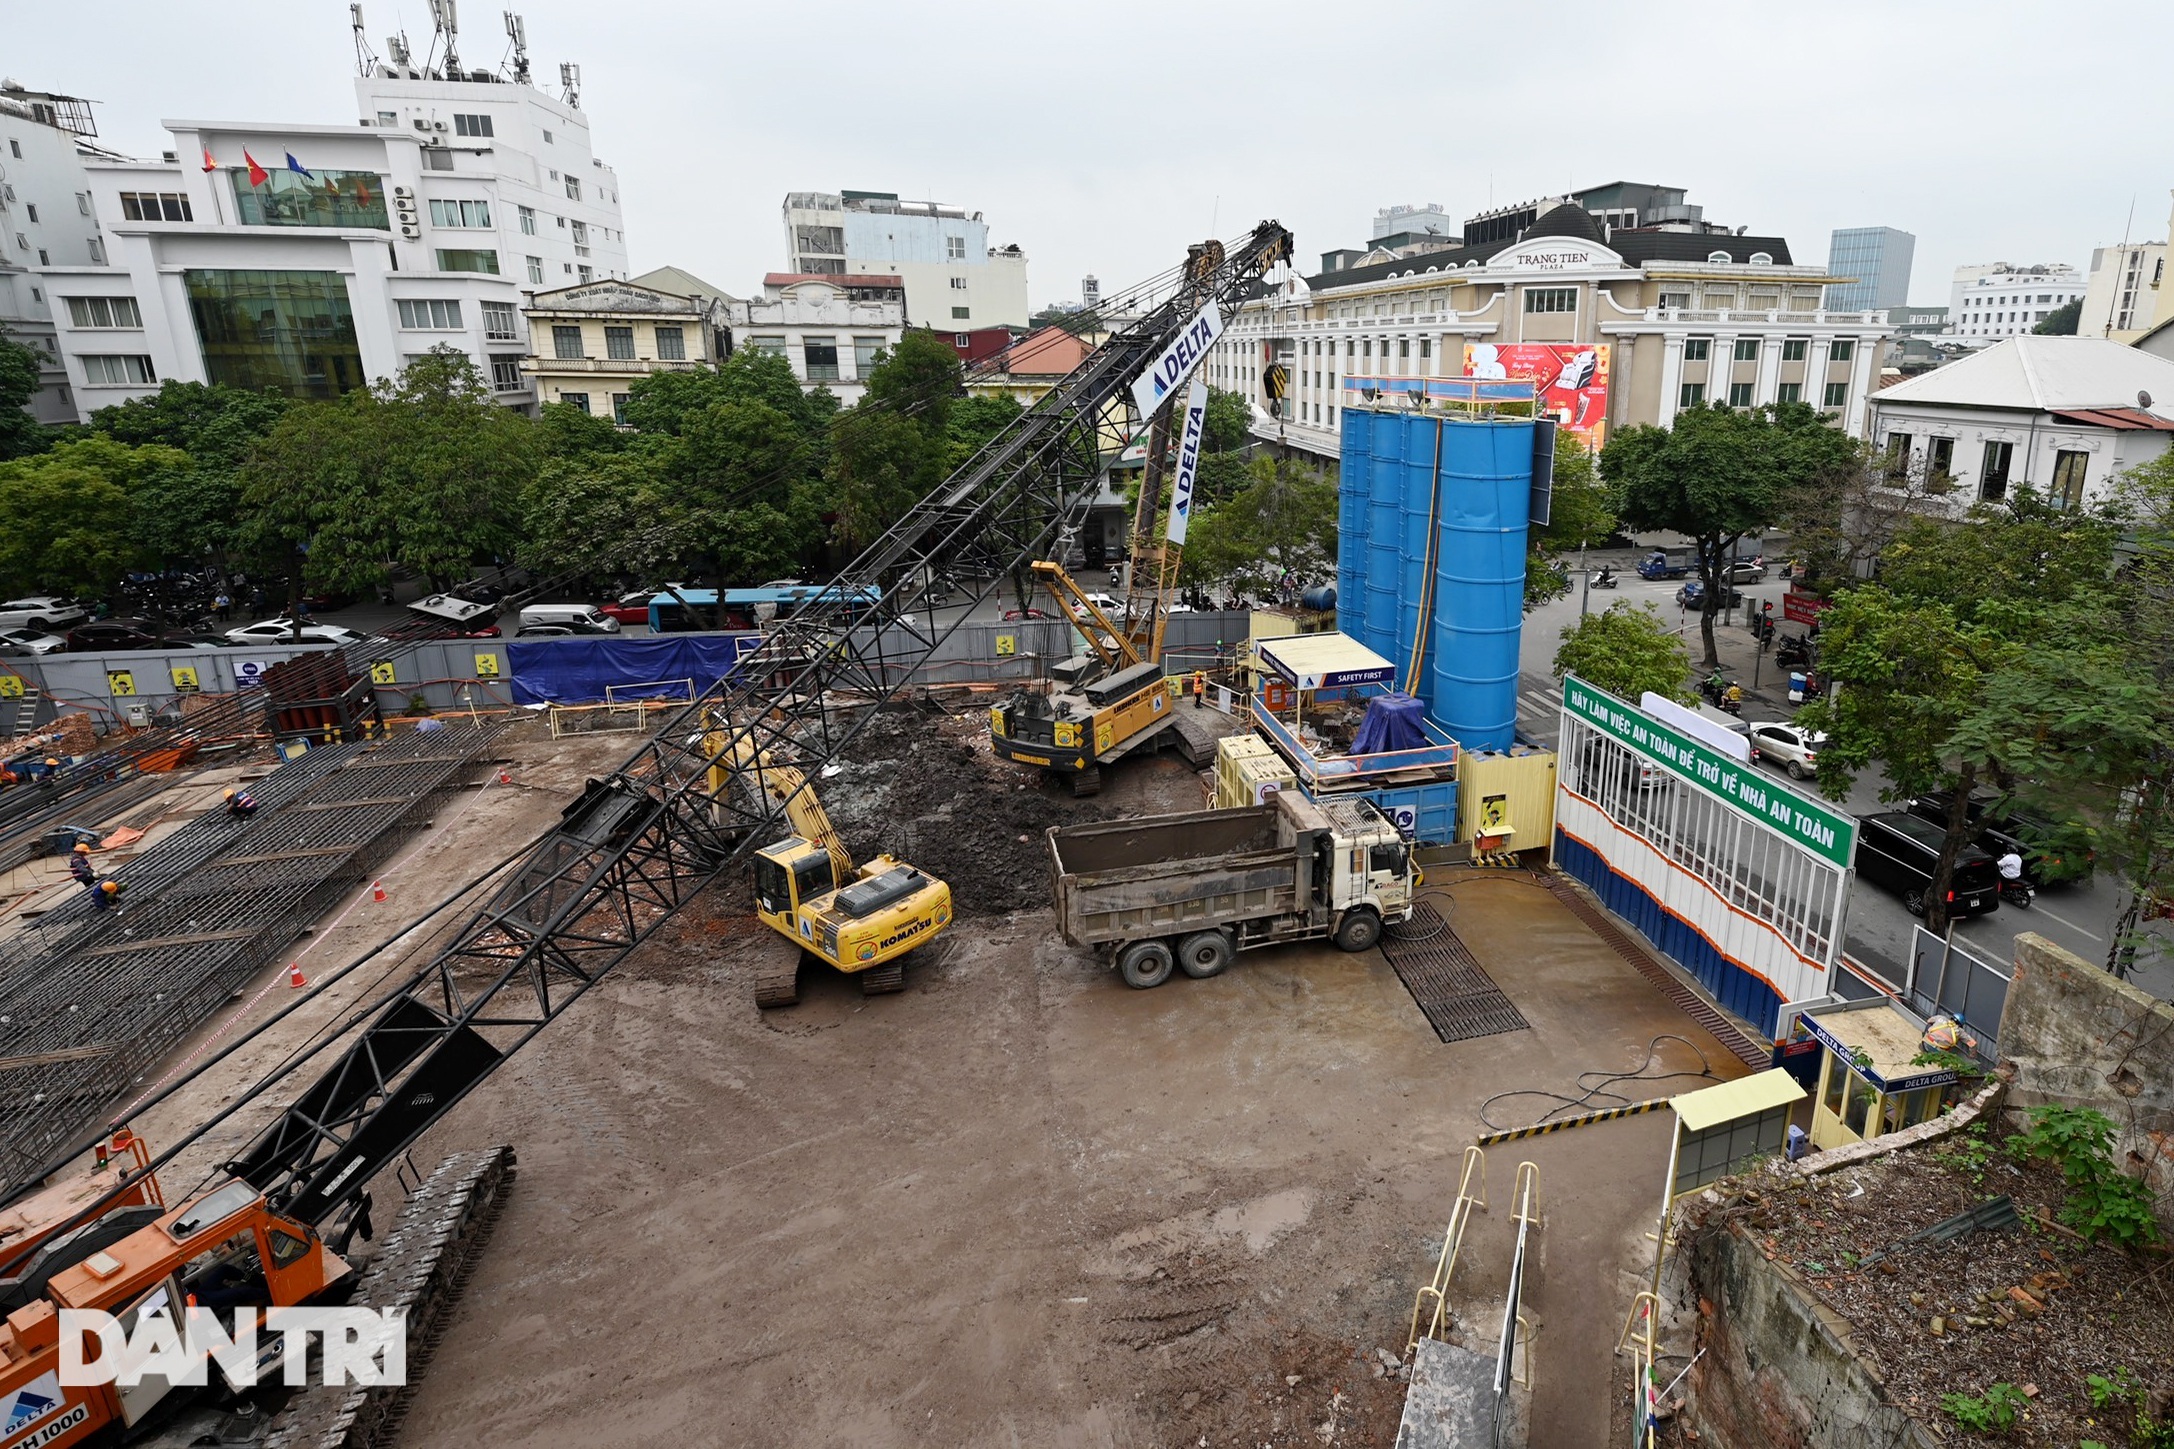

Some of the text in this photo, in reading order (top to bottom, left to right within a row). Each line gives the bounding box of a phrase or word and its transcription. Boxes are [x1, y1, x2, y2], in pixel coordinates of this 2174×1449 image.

[1517, 253, 1588, 265] TRANG TIEN
[1164, 316, 1212, 385] DELTA
[1178, 407, 1202, 494] DELTA
[209, 568, 216, 577] P
[1338, 671, 1382, 682] SAFETY FIRST
[1571, 690, 1835, 849] HÃY LÀM VIỆC AN TOÀN ĐỂ TRỞ VỀ NHÀ AN TOÀN
[880, 917, 932, 949] KOMATSU
[1816, 1028, 1838, 1055] DELTA
[1905, 1073, 1956, 1088] DELTA GROU
[5, 1401, 56, 1435] DELTA
[41, 1408, 85, 1441] 1000
